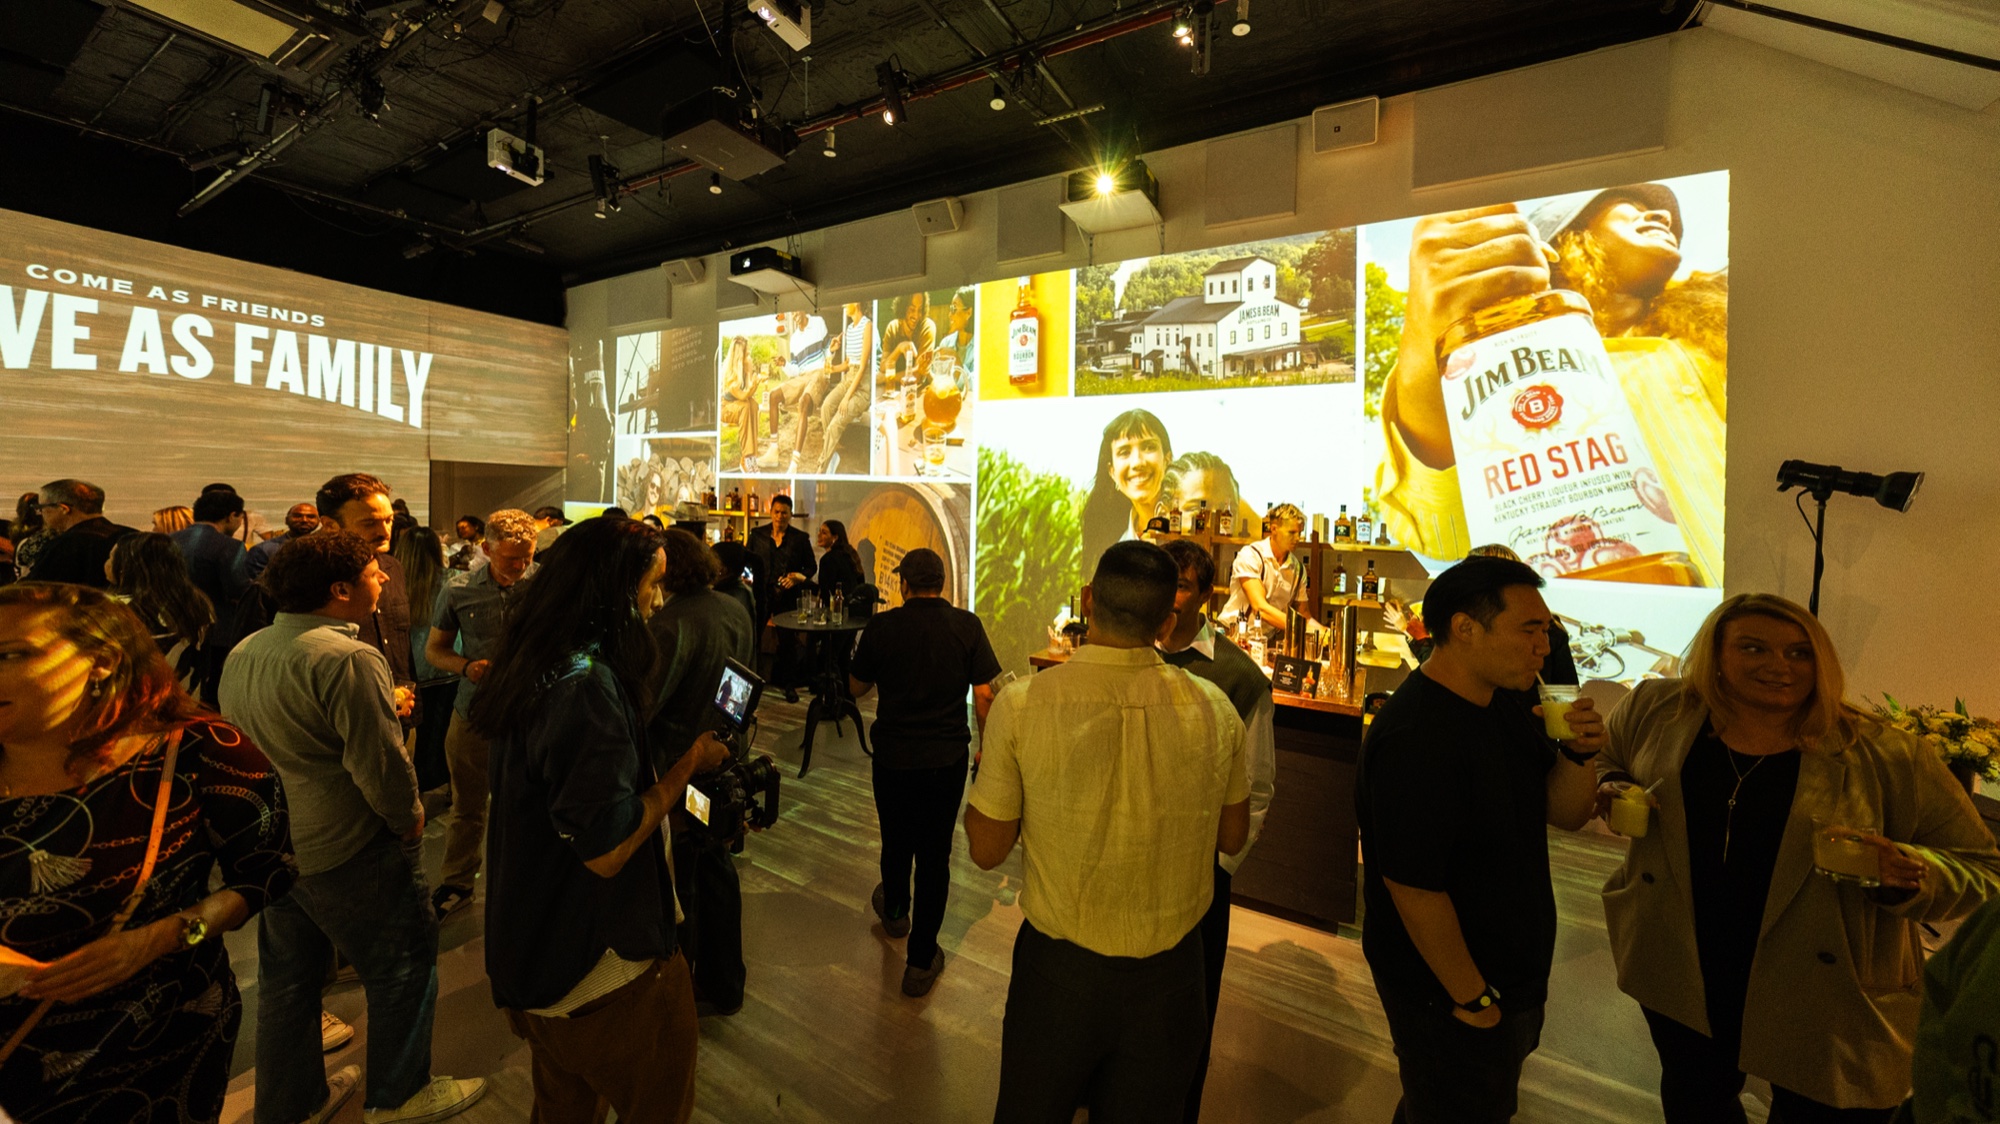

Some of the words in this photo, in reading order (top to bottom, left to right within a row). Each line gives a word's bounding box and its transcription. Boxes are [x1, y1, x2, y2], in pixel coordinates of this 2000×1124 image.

[26, 264, 133, 295] COME
[147, 286, 190, 304] AS
[201, 294, 325, 328] FRIENDS
[1238, 307, 1257, 325] JAMES
[1262, 304, 1280, 317] BEAM
[118, 305, 214, 380] AS
[234, 322, 433, 429] FAMILY
[1461, 361, 1513, 421] JIM
[1510, 346, 1608, 384] BEAM
[1483, 453, 1542, 500] RED
[1546, 432, 1629, 479] STAG
[1494, 499, 1517, 512] BLACK
[1518, 490, 1546, 506] CHERRY
[1547, 482, 1578, 498] LIQUEUR
[1580, 474, 1612, 489] INFUSED
[1611, 470, 1632, 481] WITH
[1494, 506, 1529, 524] KENTUCKY
[1530, 497, 1567, 514] STRAIGHT
[1568, 488, 1604, 503] BOURBON
[1605, 479, 1638, 495] WHISKEY
